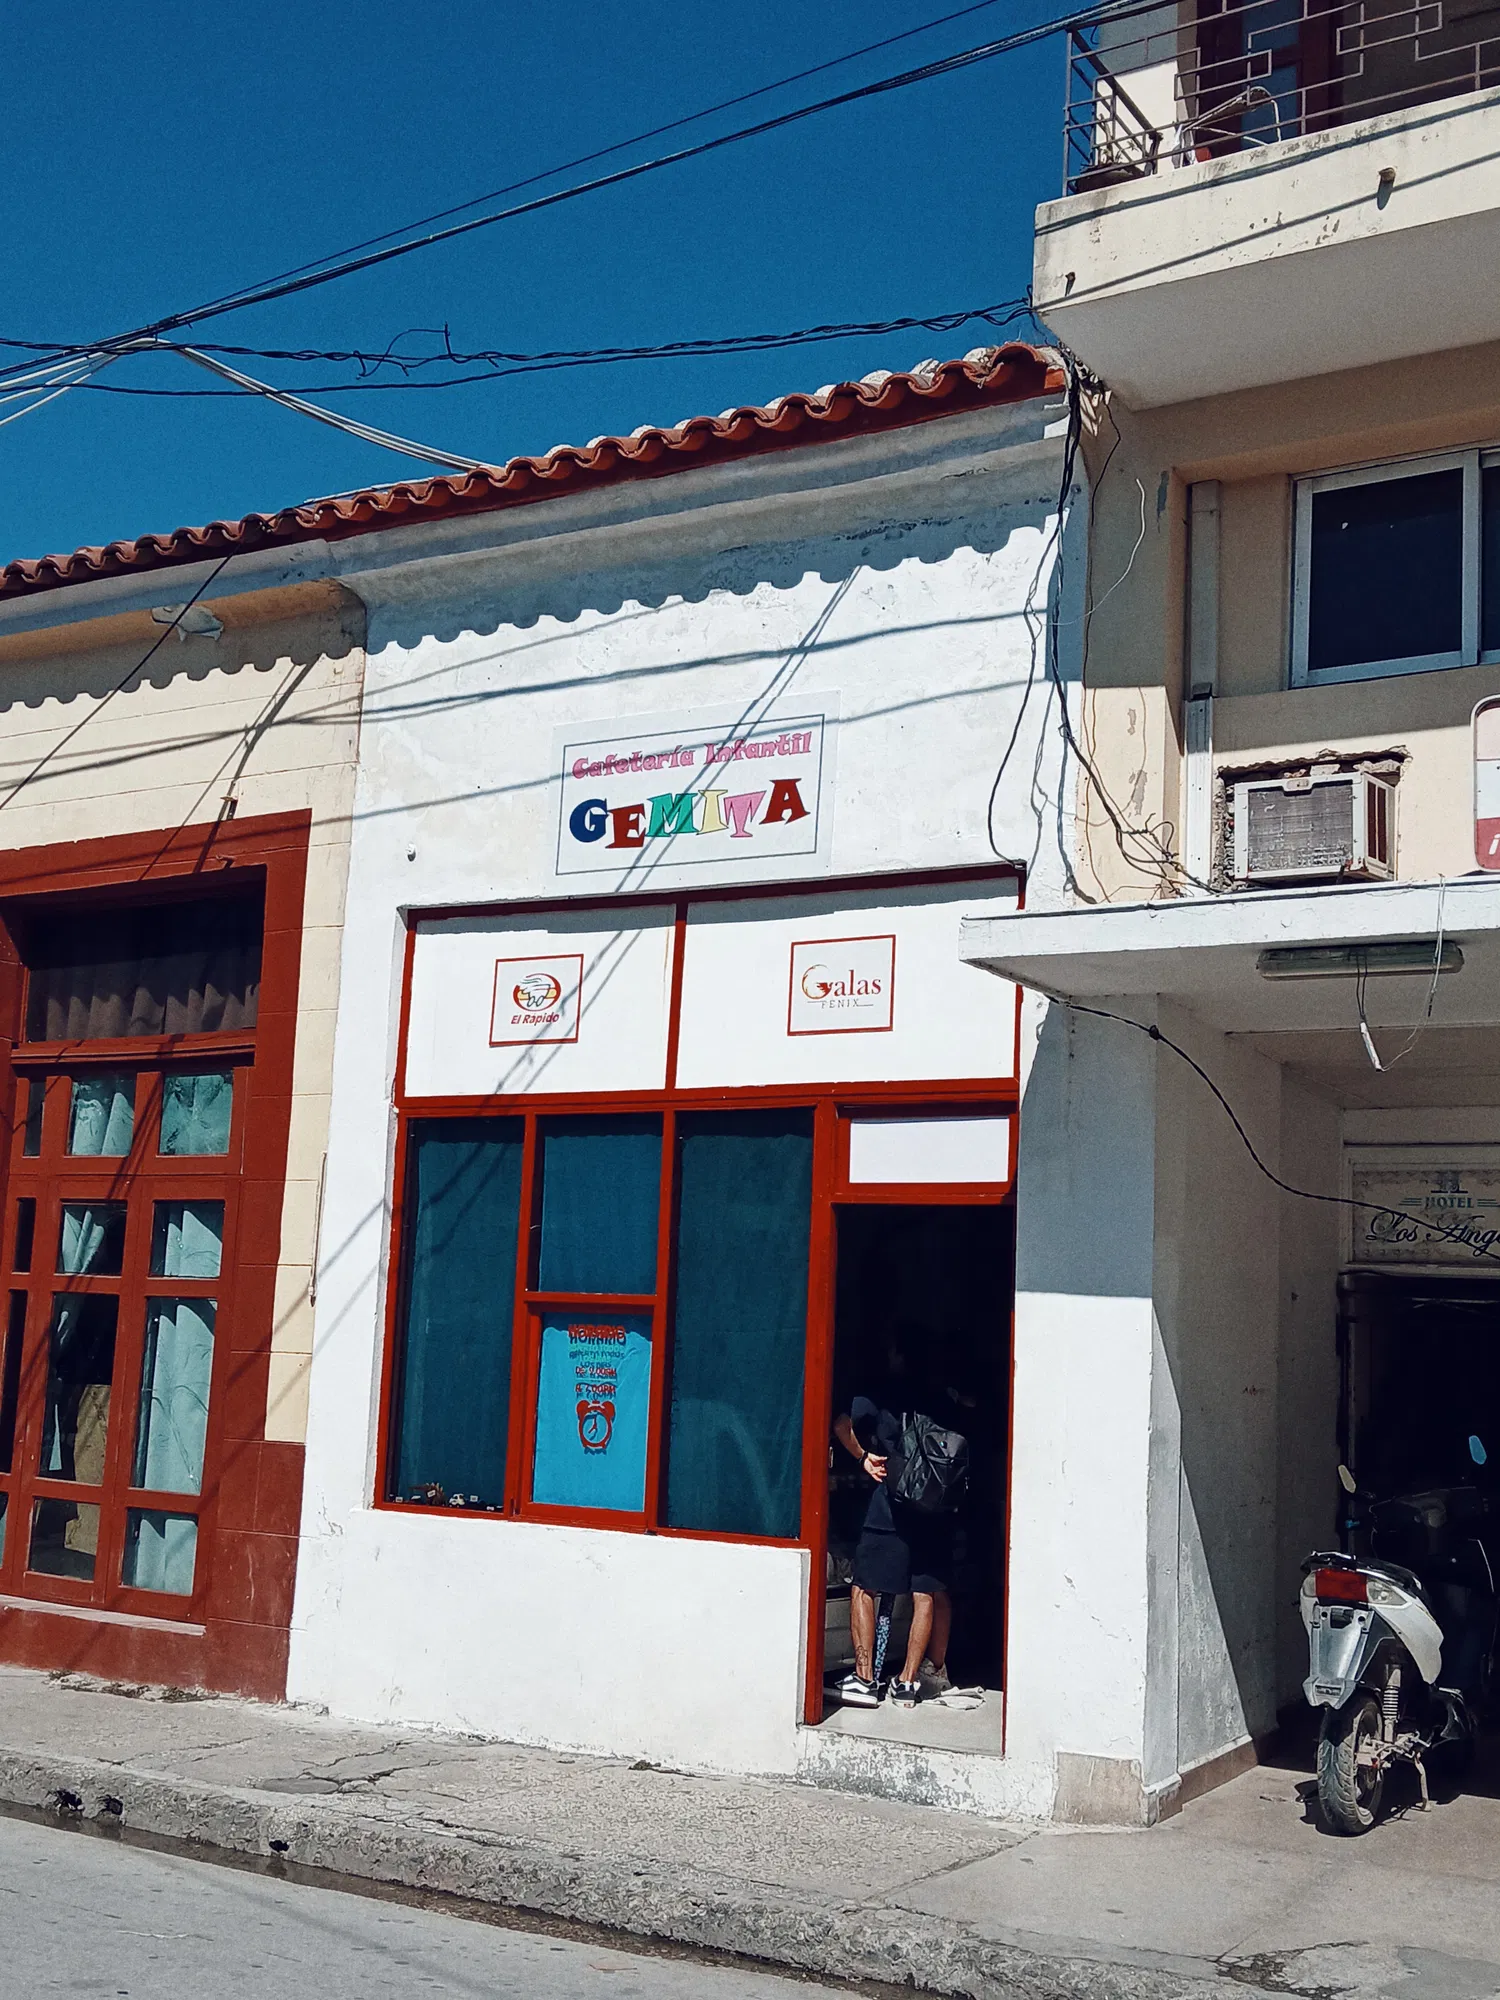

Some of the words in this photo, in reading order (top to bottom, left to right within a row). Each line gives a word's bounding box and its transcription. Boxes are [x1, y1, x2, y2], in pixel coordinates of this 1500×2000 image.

[571, 745, 696, 780] Cafetería
[703, 731, 813, 765] Infantil
[569, 778, 811, 849] GEMITA
[801, 963, 882, 1000] Galas
[821, 999, 860, 1009] FENIX
[511, 1015, 522, 1025] El
[1425, 1197, 1474, 1208] HOTEL
[1366, 1211, 1418, 1243] Los
[1426, 1215, 1500, 1257] Ang
[567, 1324, 626, 1342] HORARIO
